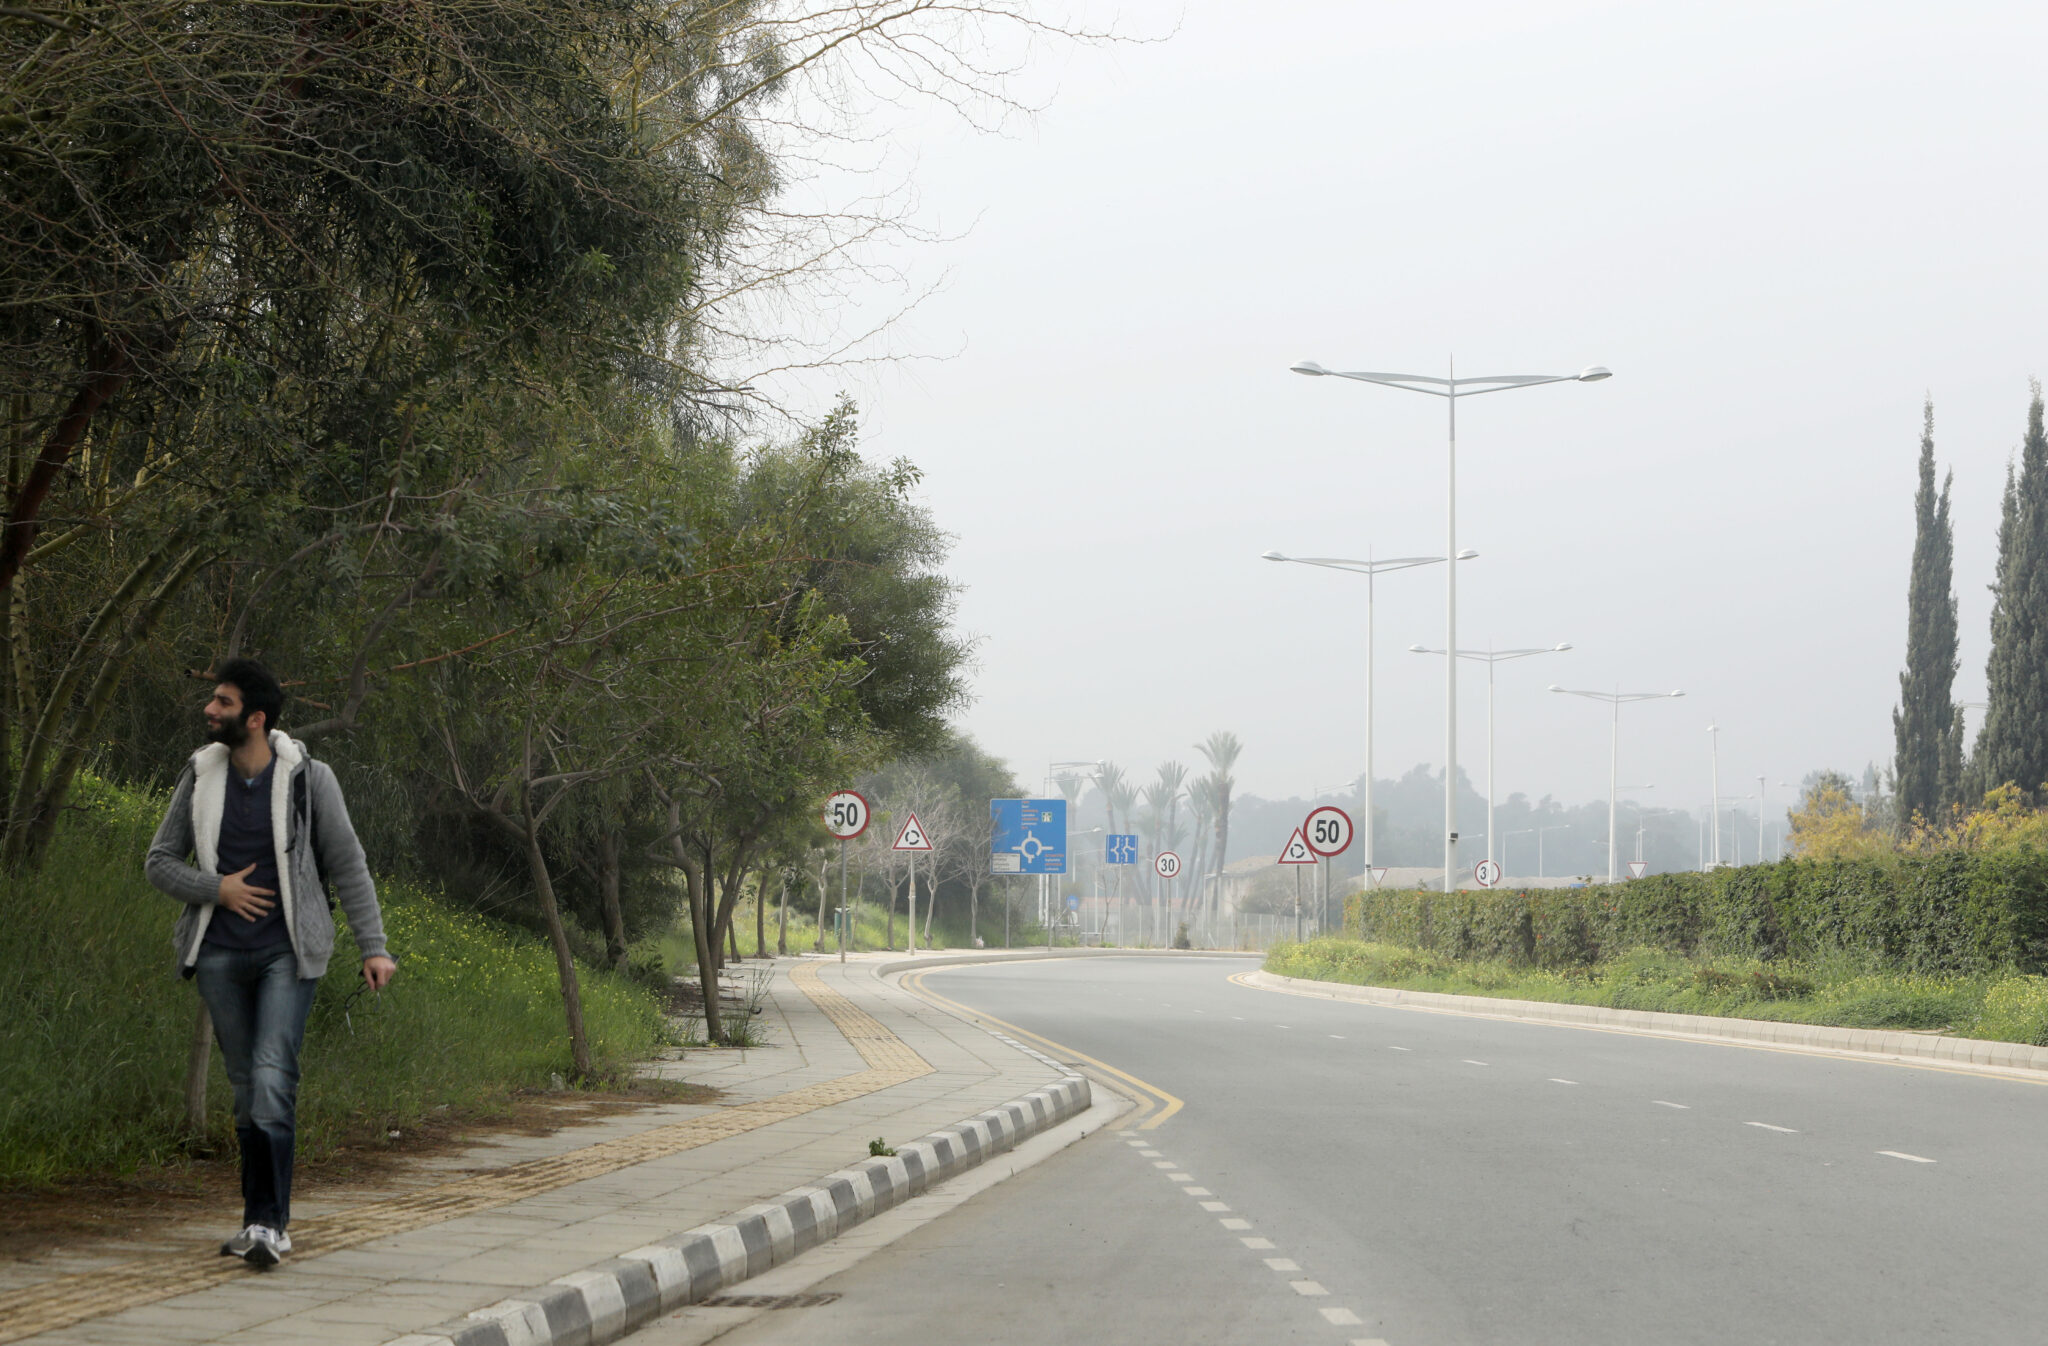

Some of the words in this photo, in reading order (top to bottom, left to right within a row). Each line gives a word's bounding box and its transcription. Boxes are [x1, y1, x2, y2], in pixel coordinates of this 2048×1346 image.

[833, 802, 858, 827] 50
[1315, 819, 1340, 844] 50
[1161, 858, 1175, 872] 30
[1480, 866, 1487, 880] 3
